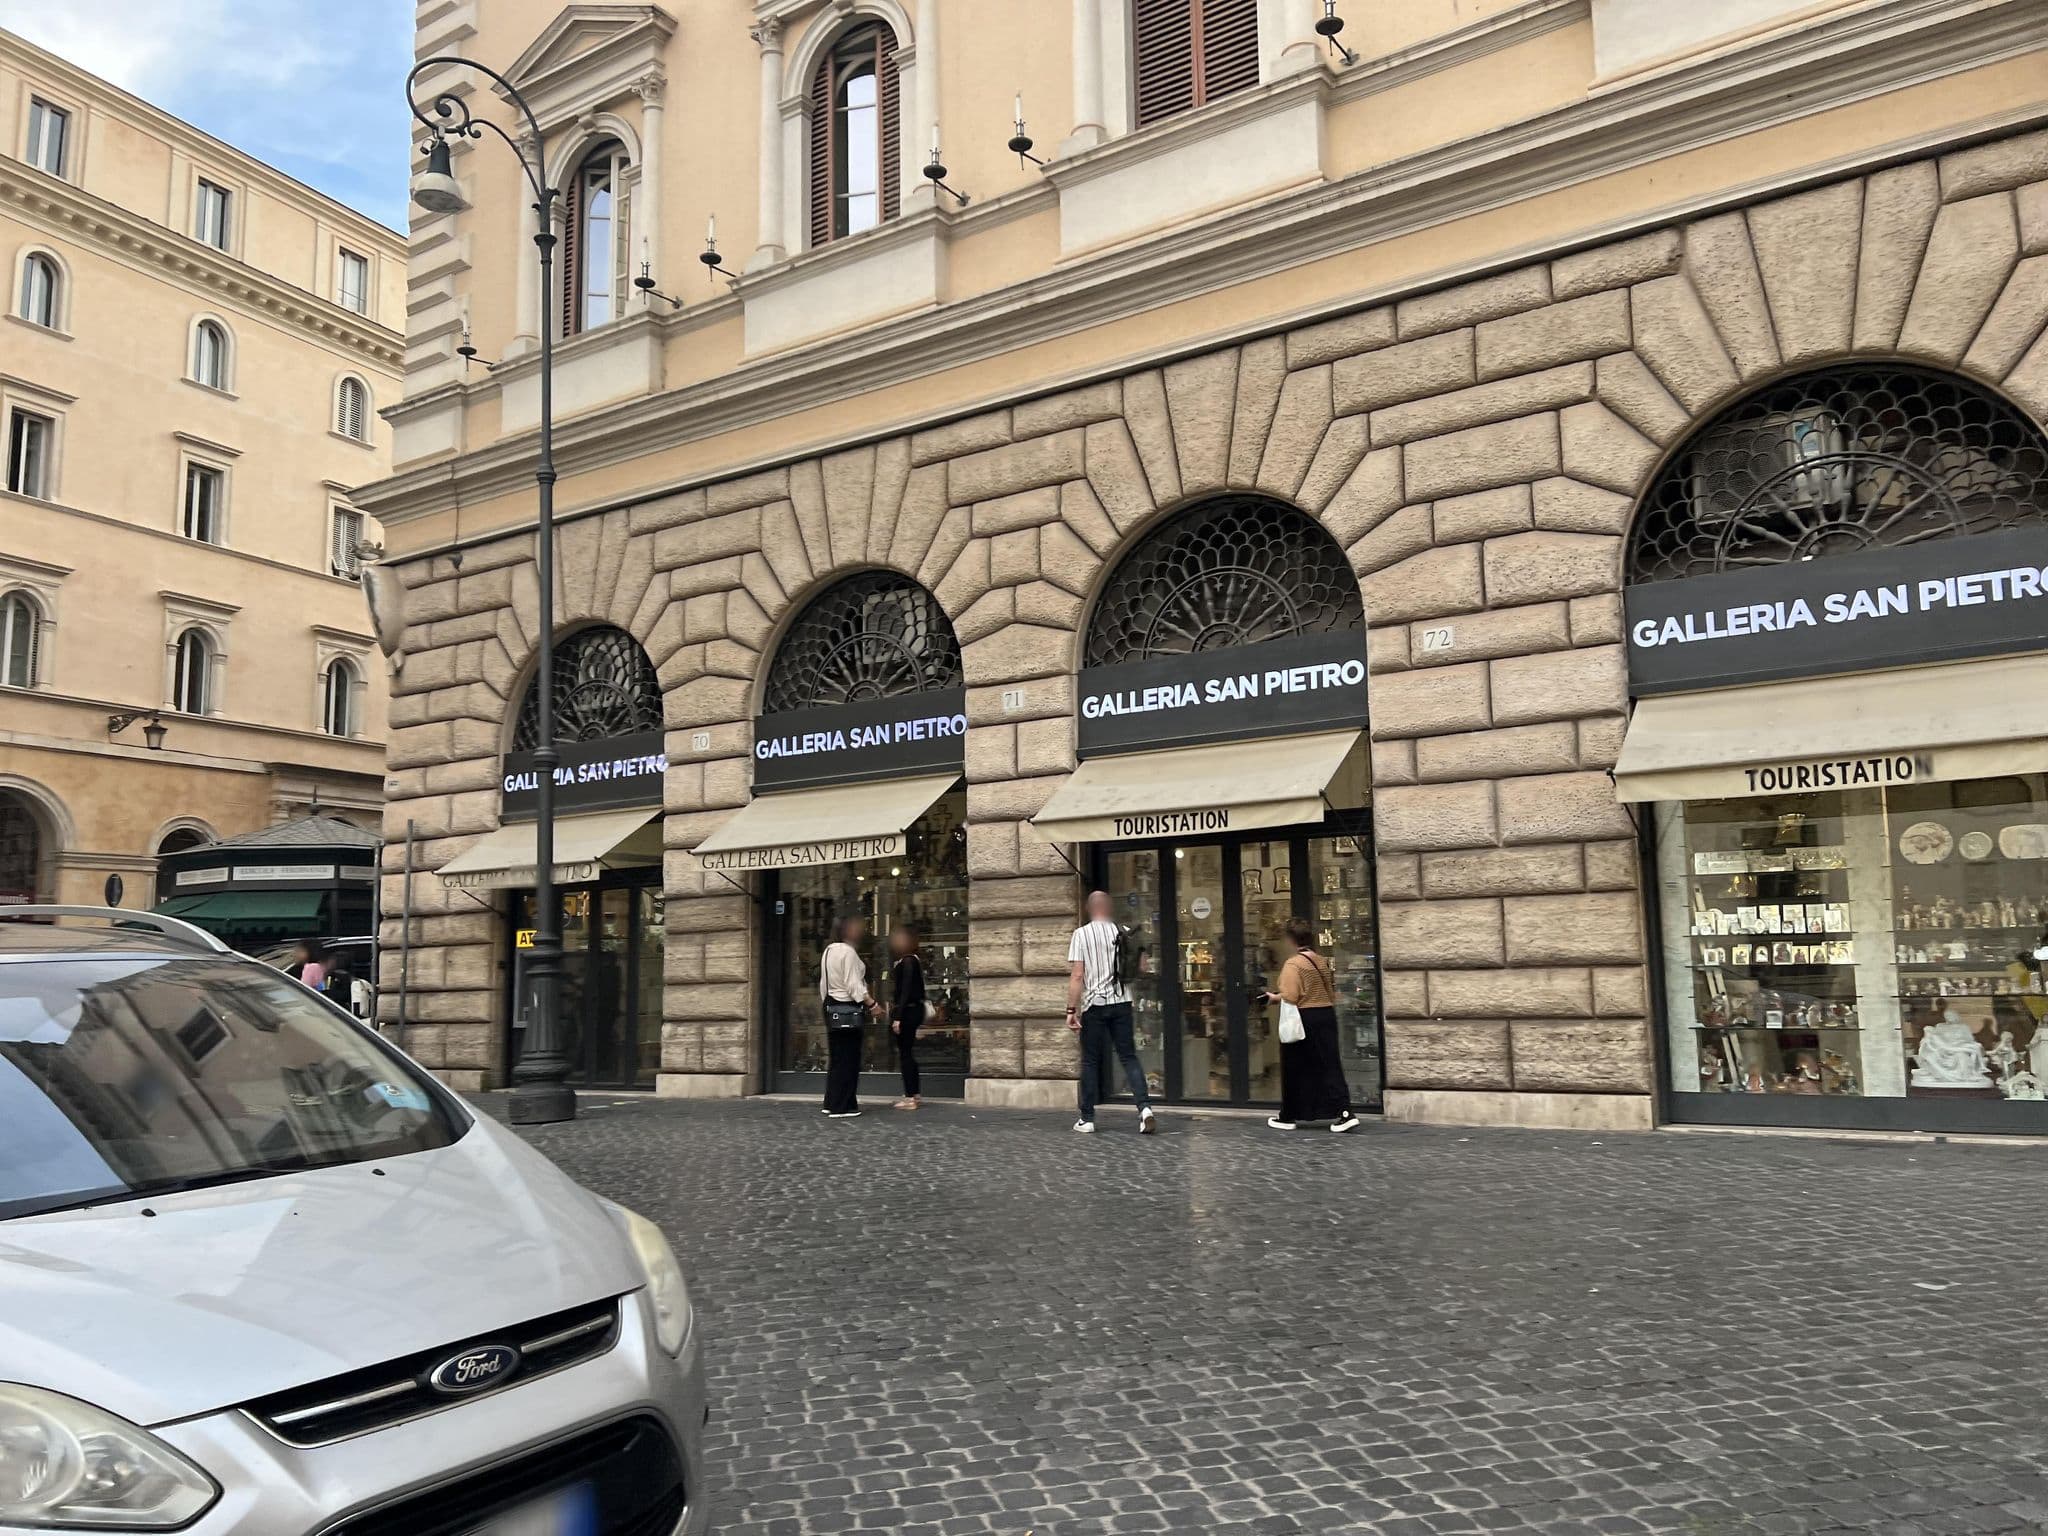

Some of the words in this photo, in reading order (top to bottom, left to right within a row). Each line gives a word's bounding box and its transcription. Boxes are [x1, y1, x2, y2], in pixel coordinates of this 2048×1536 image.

[1632, 598, 1817, 648] GALLERIA
[1823, 584, 1909, 623] SAN
[1425, 629, 1452, 648] 72
[1004, 691, 1019, 707] 71
[1082, 682, 1200, 718] GALLERIA
[1205, 673, 1258, 703] SAN
[1265, 659, 1365, 695] PIETRO
[694, 735, 708, 749] 70
[756, 730, 846, 759] GALLERIA
[850, 723, 890, 748] SAN
[895, 714, 968, 742] PIETRO
[504, 767, 575, 792] GALLRIA
[578, 762, 610, 783] SAN
[1114, 809, 1229, 837] TOURISTATION
[702, 849, 786, 870] GALLERIA
[790, 843, 828, 864] SAN
[832, 836, 897, 860] PIETRO
[455, 1353, 501, 1382] Ford
